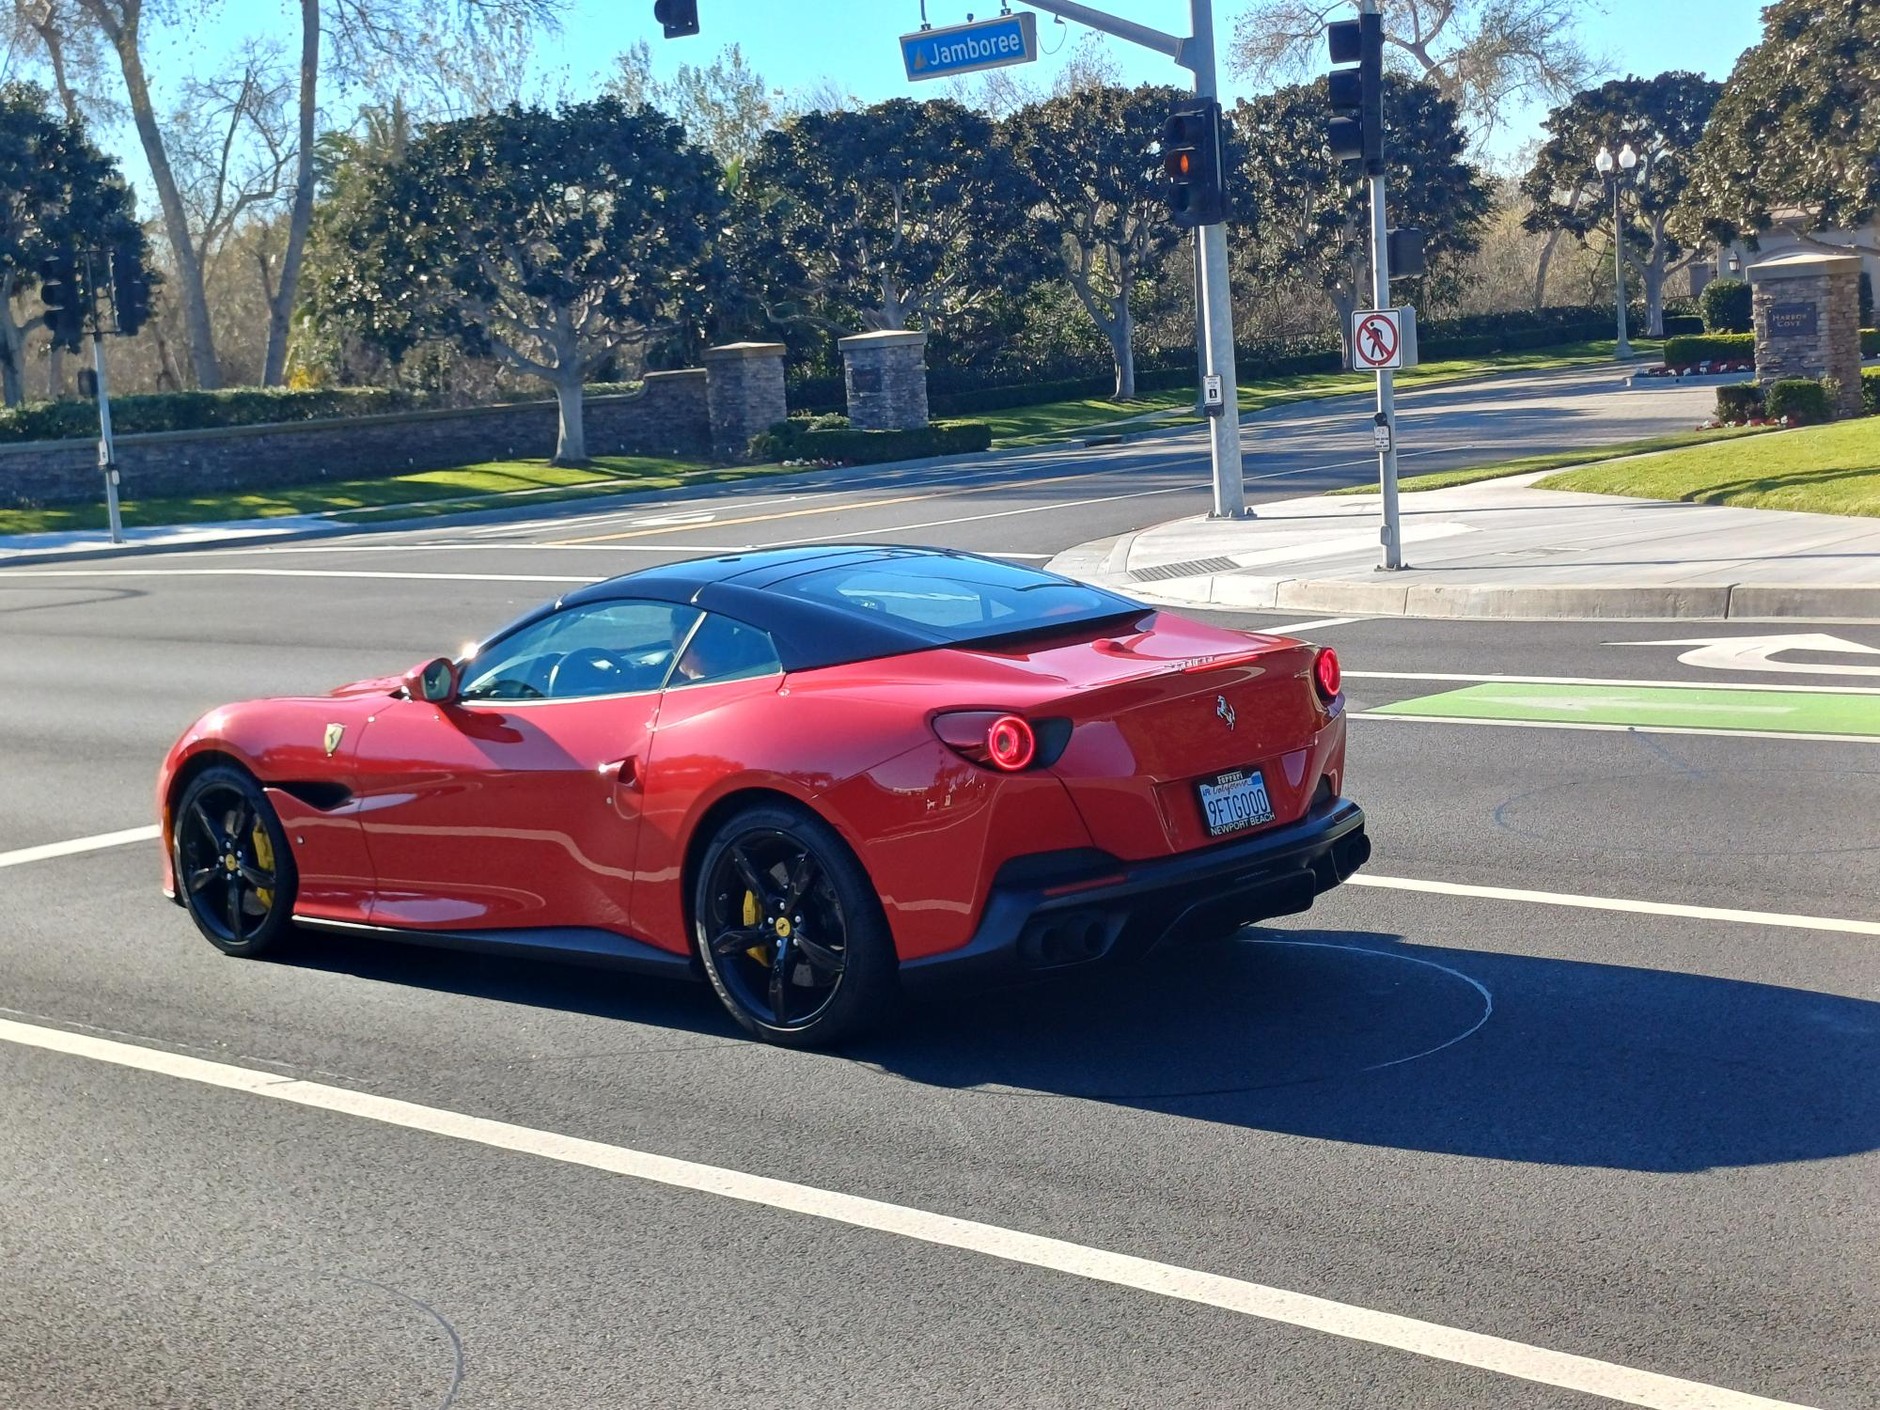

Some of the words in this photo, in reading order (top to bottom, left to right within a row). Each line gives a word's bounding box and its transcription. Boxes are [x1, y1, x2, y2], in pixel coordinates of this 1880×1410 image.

[930, 33, 1020, 66] Jamboree
[1217, 771, 1243, 784] Ferrari
[1208, 788, 1268, 826] 9FTG000
[1210, 819, 1248, 836] NEWPORT
[1250, 813, 1276, 826] BEACH
